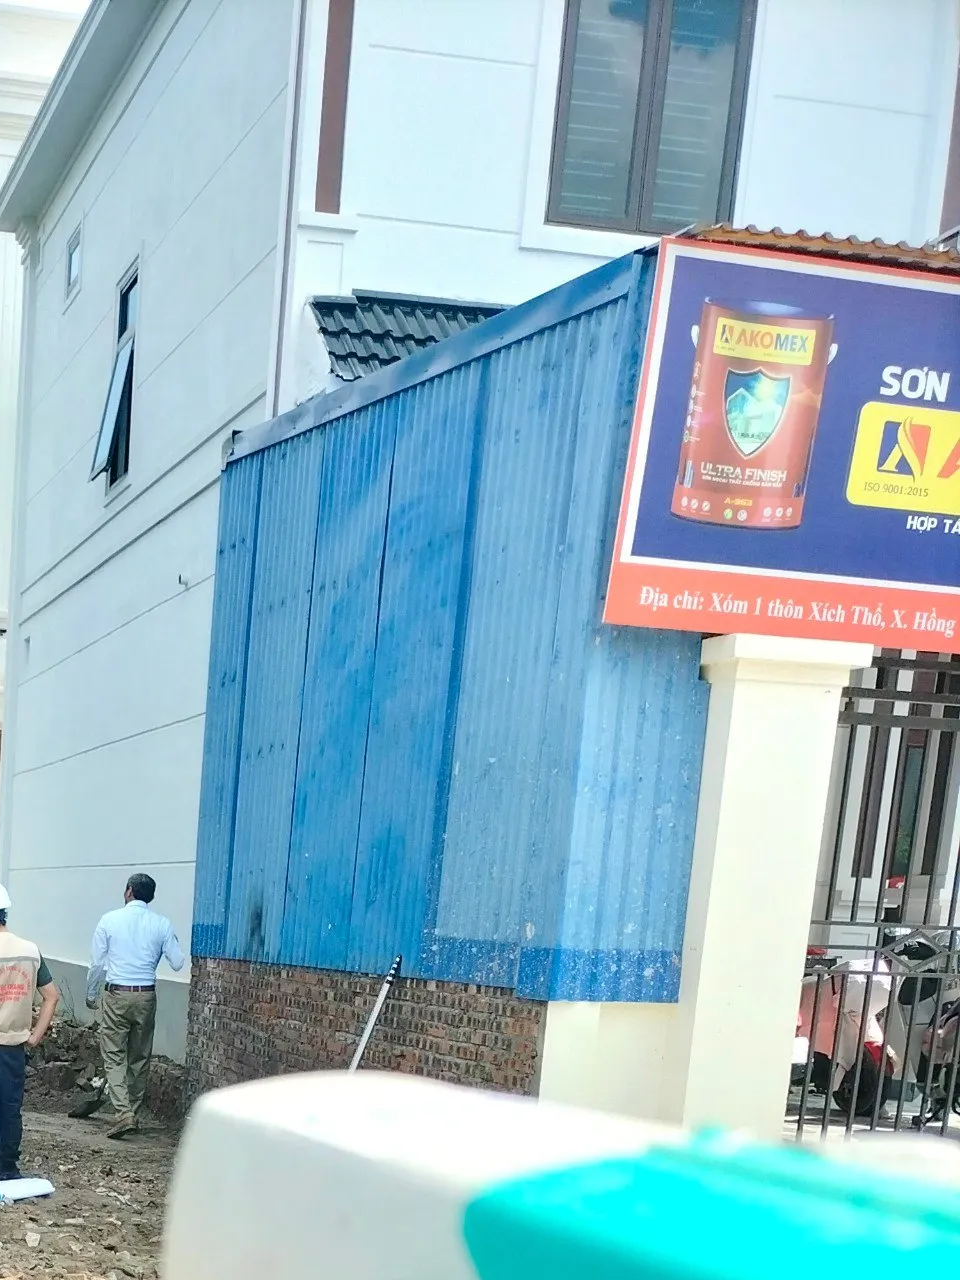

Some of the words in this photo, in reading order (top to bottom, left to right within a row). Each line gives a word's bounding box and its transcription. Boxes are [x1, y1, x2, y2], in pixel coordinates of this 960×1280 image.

[735, 328, 809, 353] AKOMEX
[880, 365, 951, 402] SƠN
[700, 461, 742, 479] ULTRA
[744, 468, 787, 482] FINISH
[863, 481, 880, 492] ISO
[882, 482, 929, 497] 9001:2015
[906, 515, 938, 533] HỢP
[640, 585, 668, 611] Địa
[673, 590, 704, 611] chỉ:
[708, 592, 748, 615] Xóm
[753, 596, 762, 616] 1
[767, 598, 803, 619] thôn
[807, 601, 845, 623] Xích
[889, 609, 908, 629] X.
[913, 607, 956, 638] Hồng
